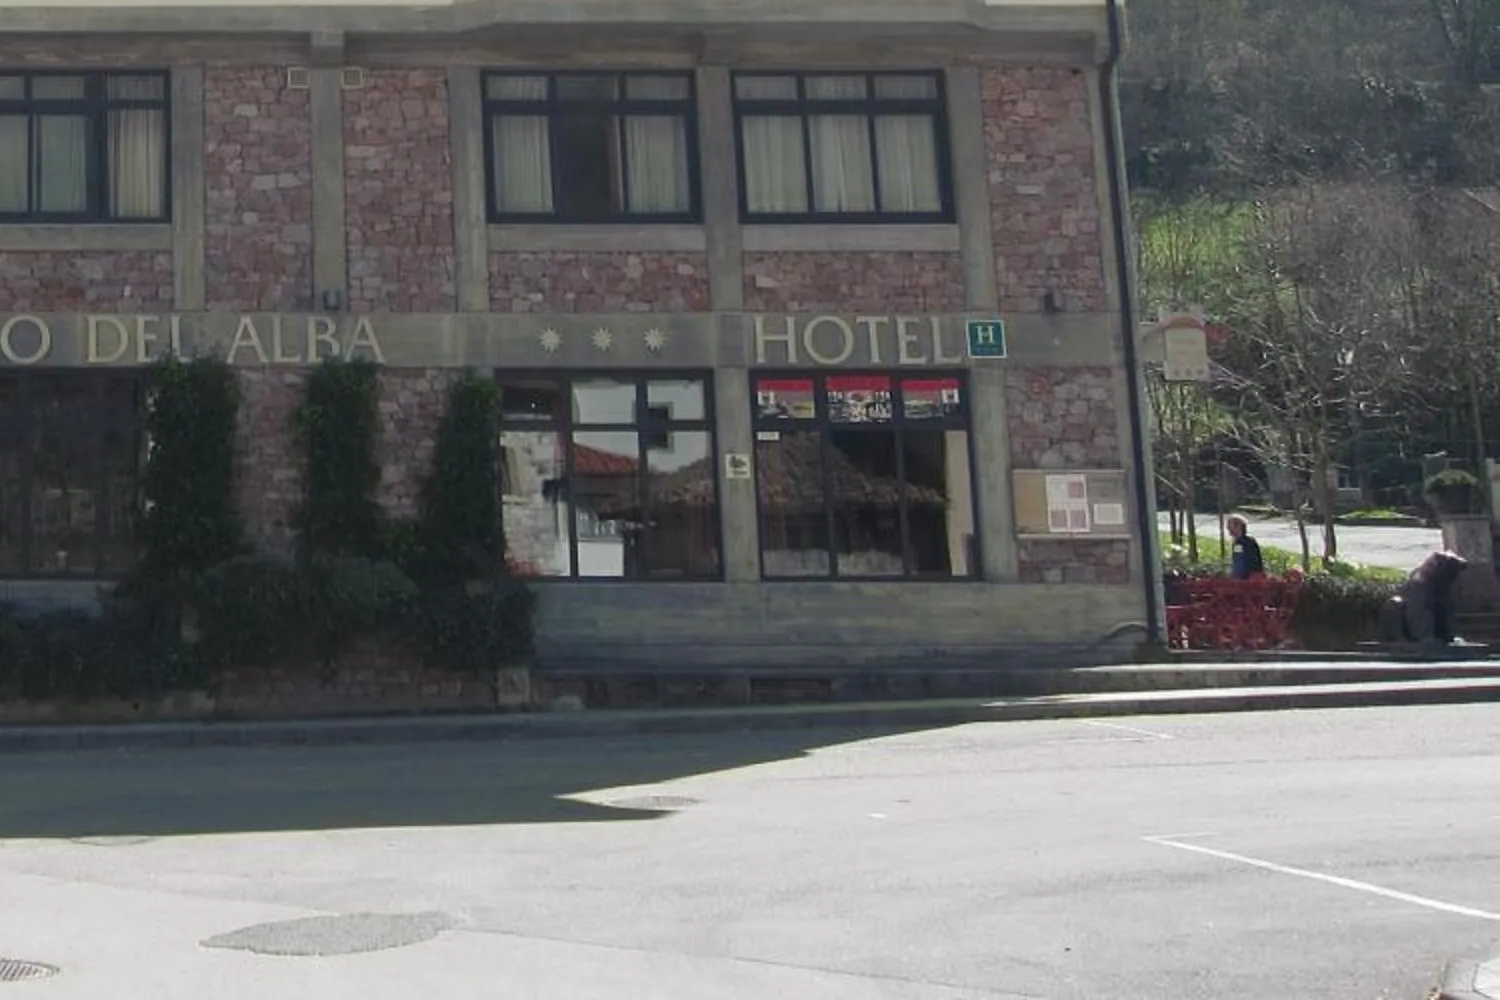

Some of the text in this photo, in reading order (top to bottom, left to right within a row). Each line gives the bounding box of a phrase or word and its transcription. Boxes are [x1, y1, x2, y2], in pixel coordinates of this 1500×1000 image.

[87, 315, 192, 363] DEL
[227, 314, 386, 364] ALBA
[754, 315, 963, 365] HOTEL
[975, 325, 996, 345] H
